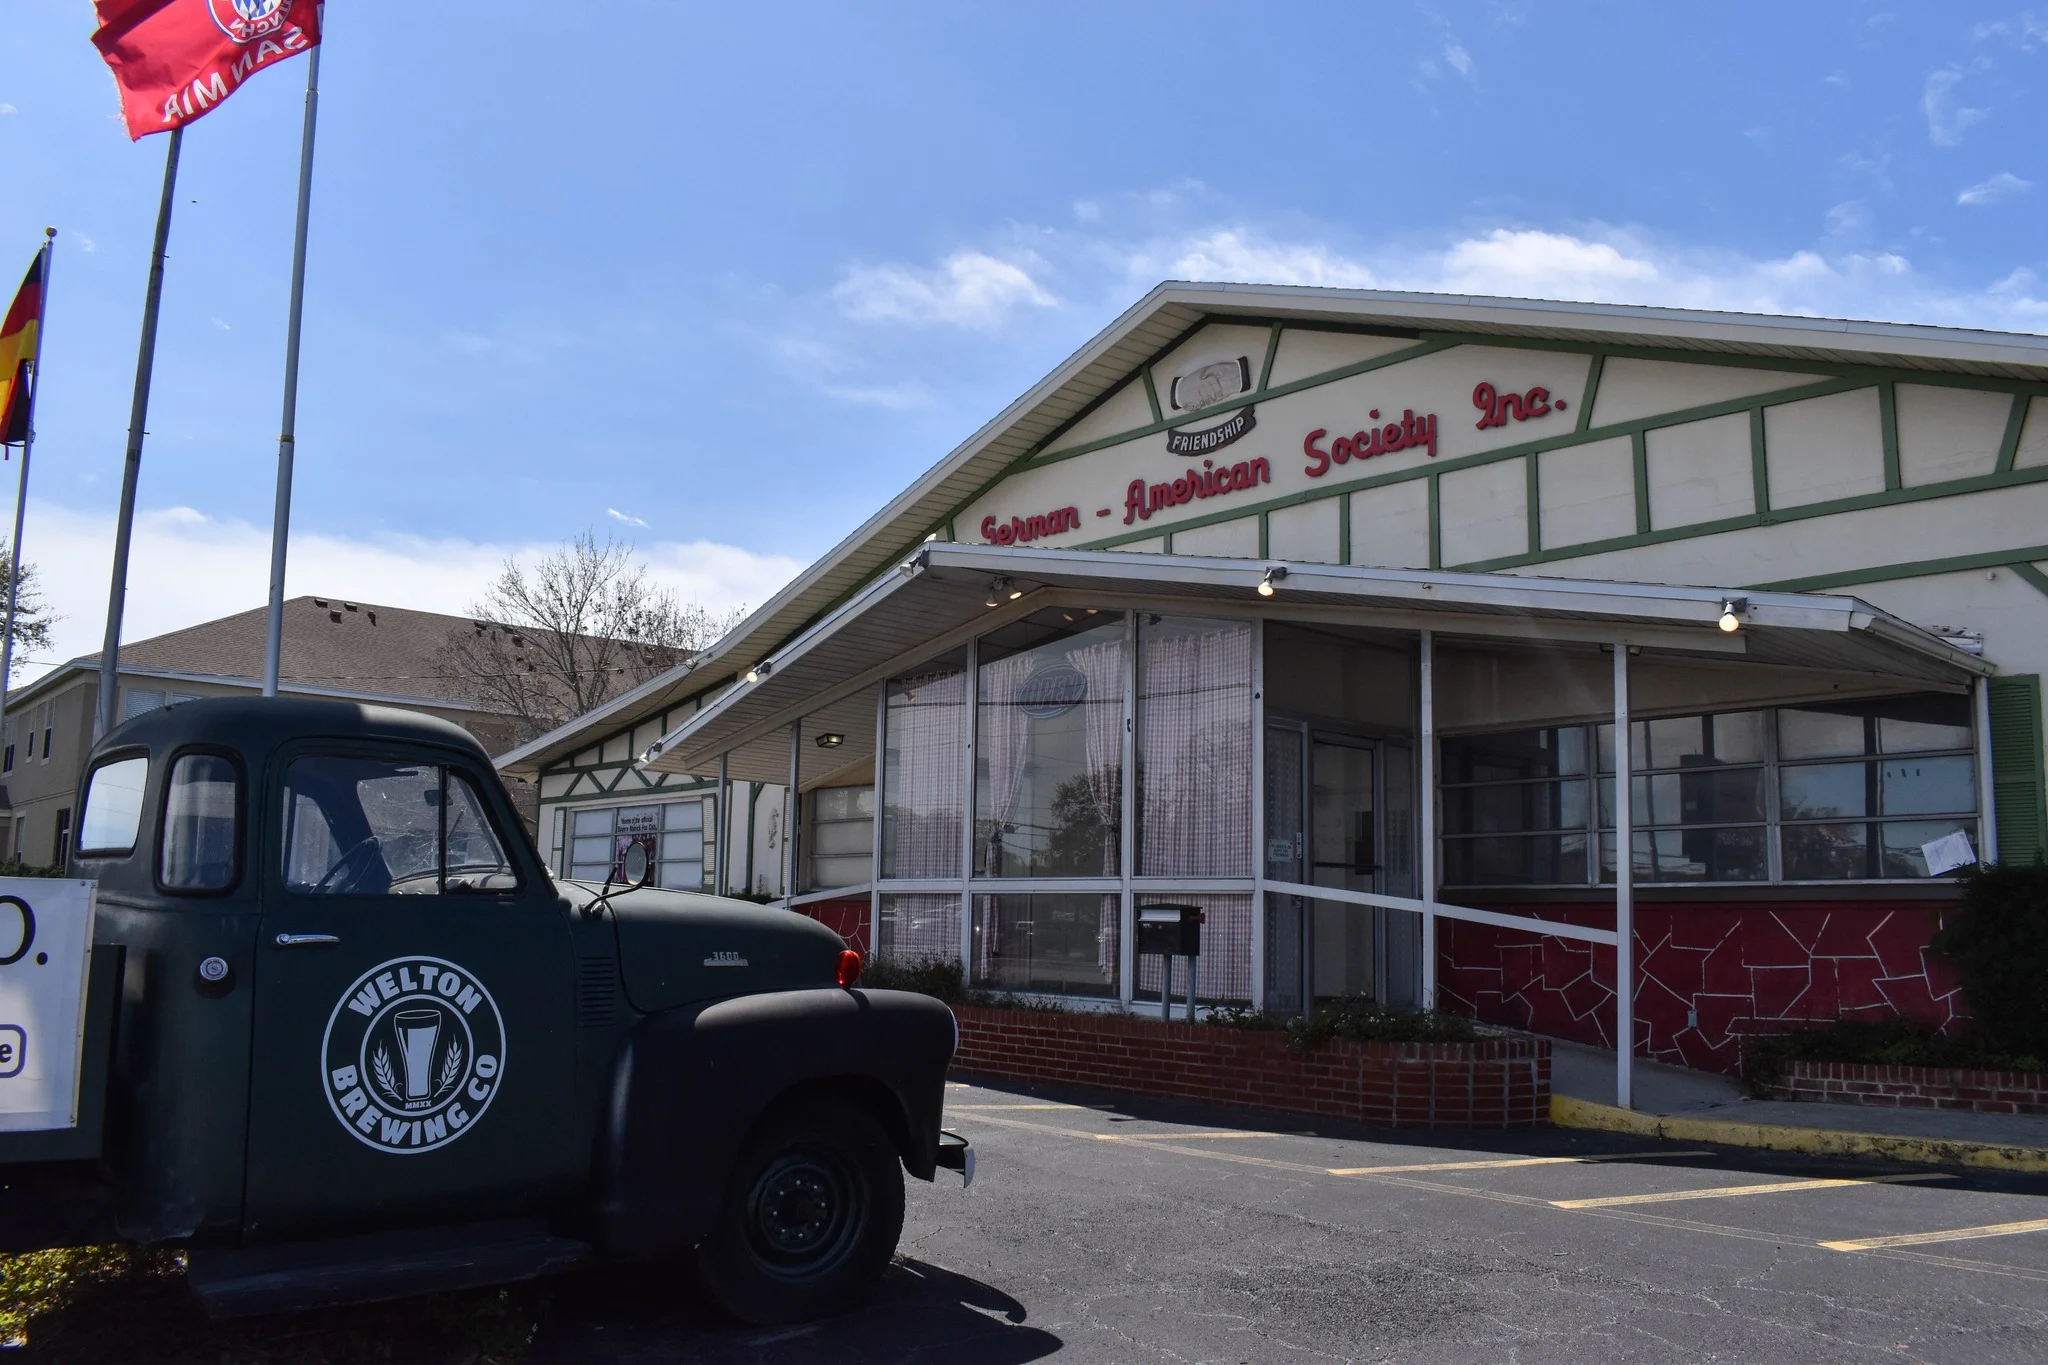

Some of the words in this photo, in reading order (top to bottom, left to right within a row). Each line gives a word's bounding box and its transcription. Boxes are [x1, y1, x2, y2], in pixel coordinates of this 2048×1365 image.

[1171, 415, 1245, 452] FRIENDSHIP
[980, 506, 1081, 546] German
[1123, 456, 1271, 525] American
[1303, 408, 1438, 478] Society
[1472, 381, 1568, 431] Inc.
[712, 951, 739, 961] 3600
[348, 965, 483, 1017] WELTON
[332, 1064, 470, 1146] BREWING
[467, 1054, 498, 1101] CO
[405, 1100, 432, 1110] MMXX
